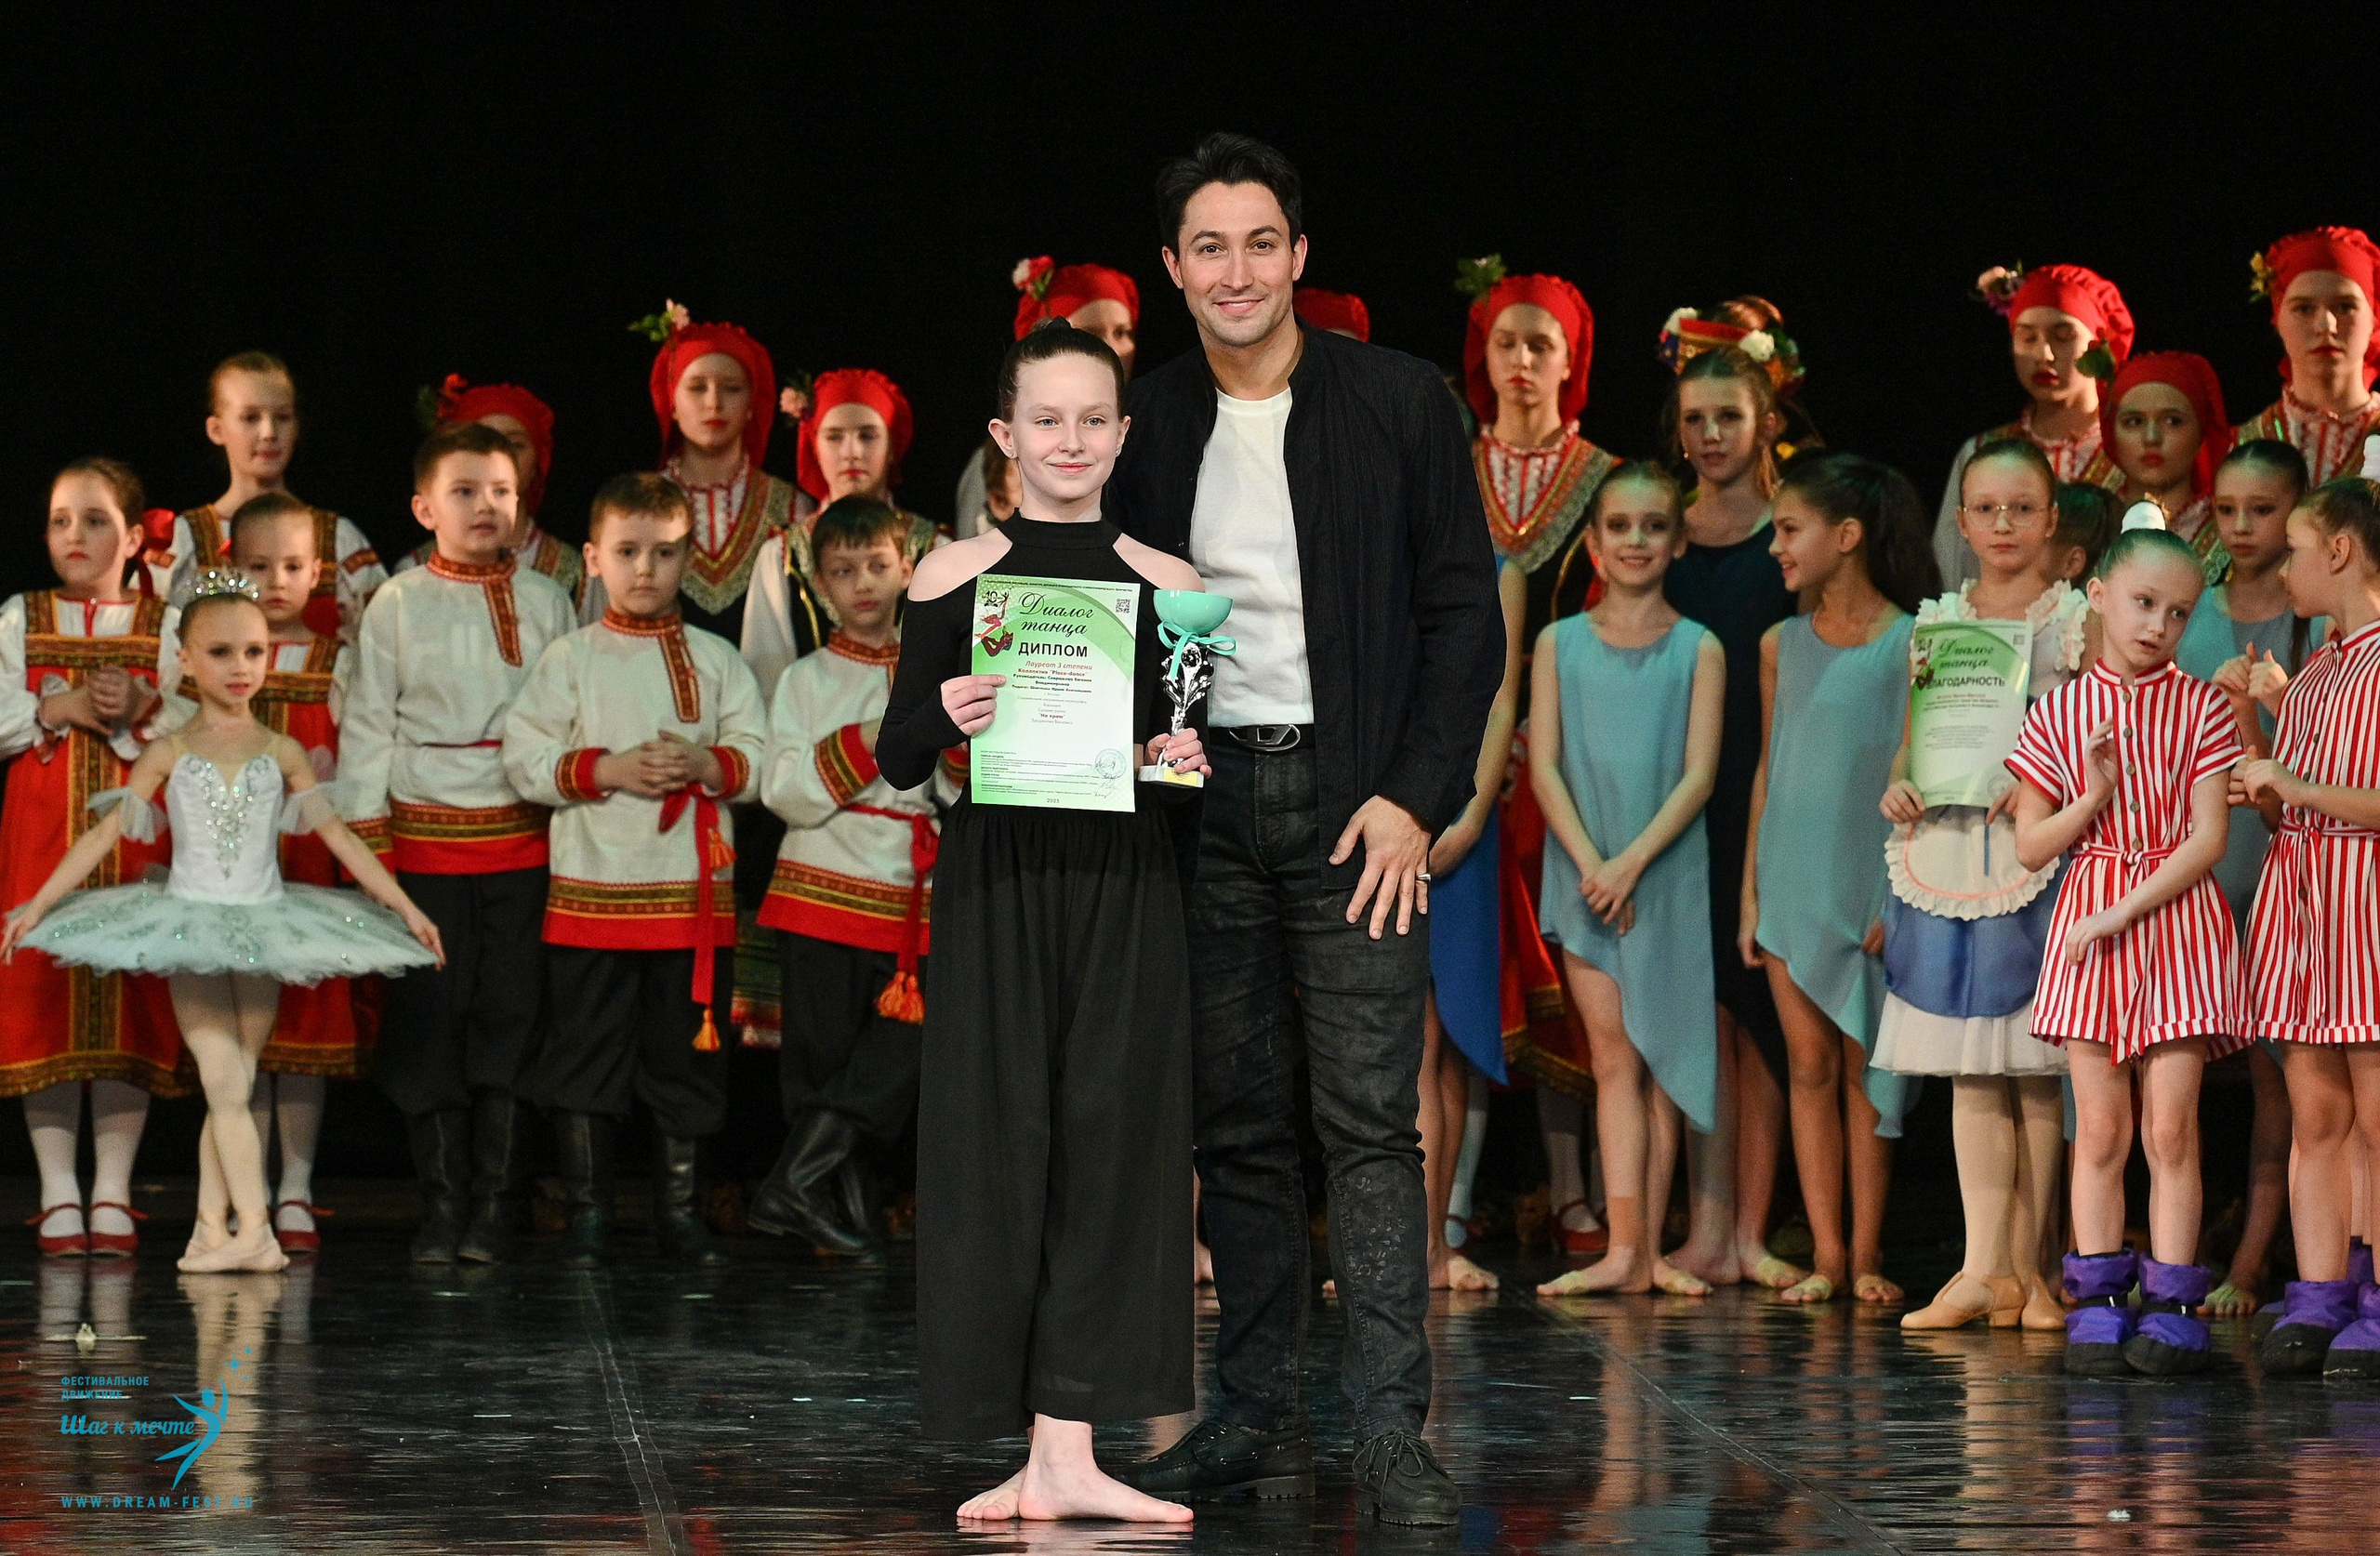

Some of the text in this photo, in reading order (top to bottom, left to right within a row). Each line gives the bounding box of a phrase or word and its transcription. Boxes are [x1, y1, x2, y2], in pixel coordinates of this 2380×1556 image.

[1018, 591, 1094, 618] Диалог
[1021, 620, 1088, 637] танца
[1018, 642, 1088, 657] ДИПЛОМ
[1025, 660, 1056, 668] Лауреат
